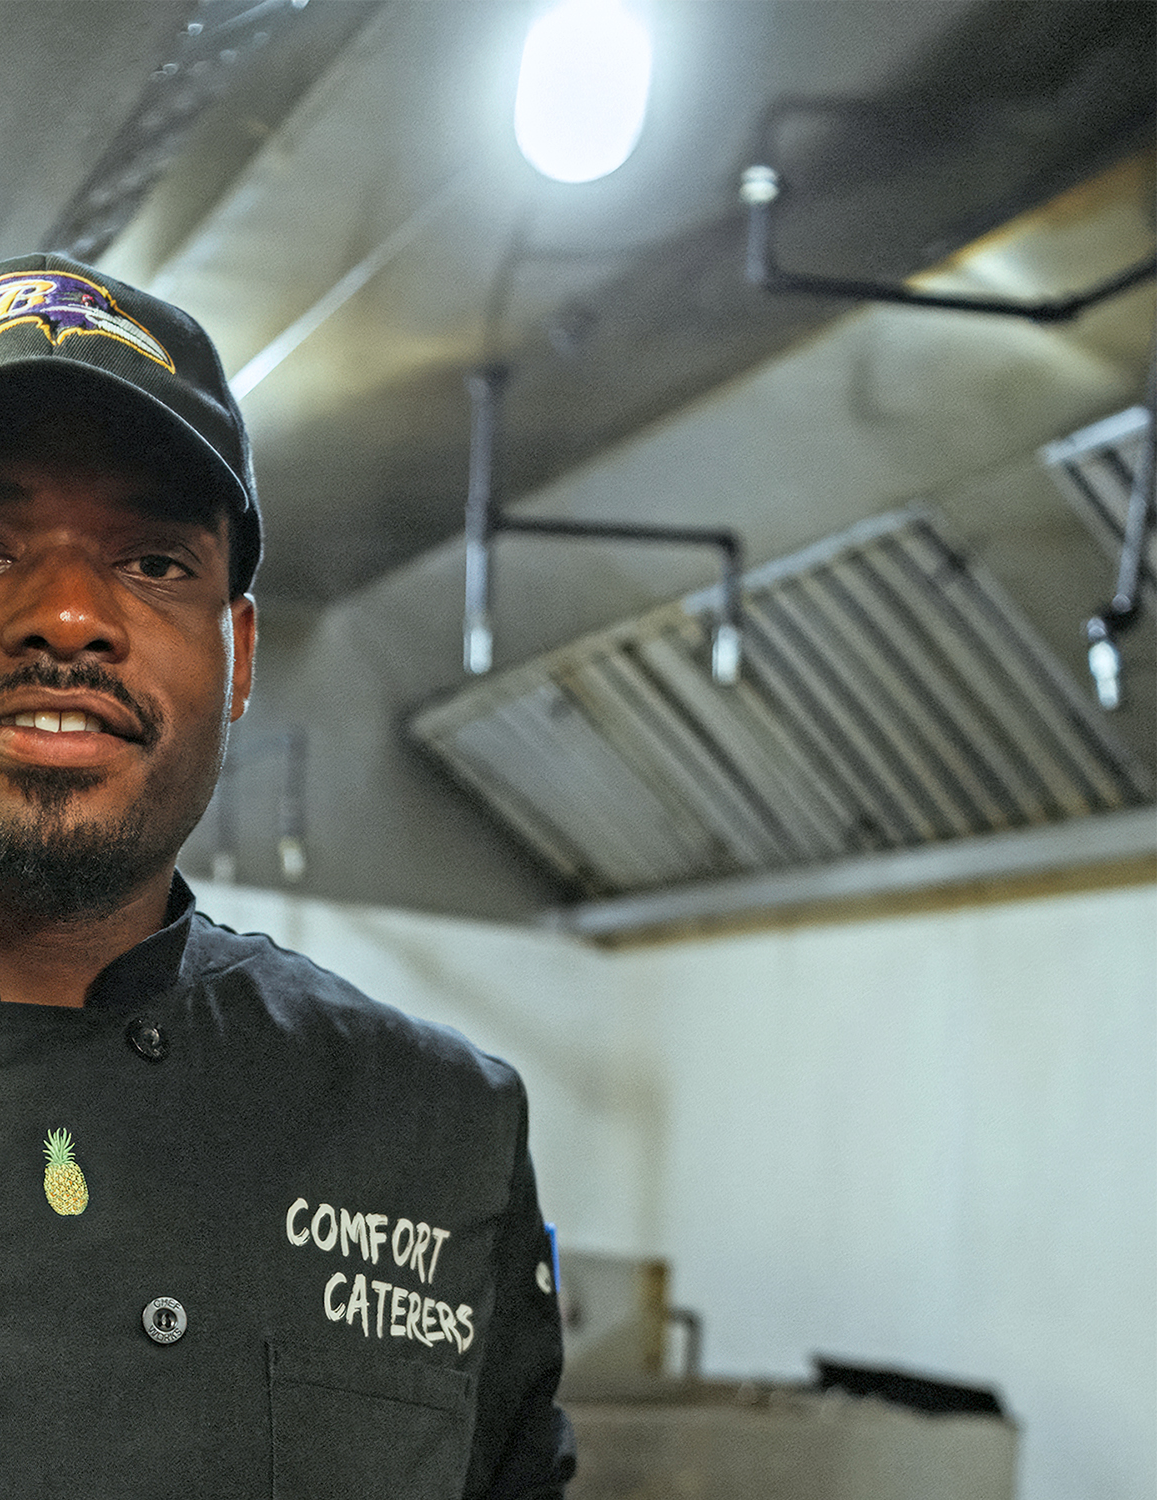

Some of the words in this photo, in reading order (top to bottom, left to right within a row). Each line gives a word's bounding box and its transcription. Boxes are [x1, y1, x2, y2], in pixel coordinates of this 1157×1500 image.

[286, 1197, 451, 1284] COMFORT
[152, 1298, 181, 1310] CHEF
[323, 1271, 475, 1354] CATERERS
[148, 1324, 183, 1342] WORKS
